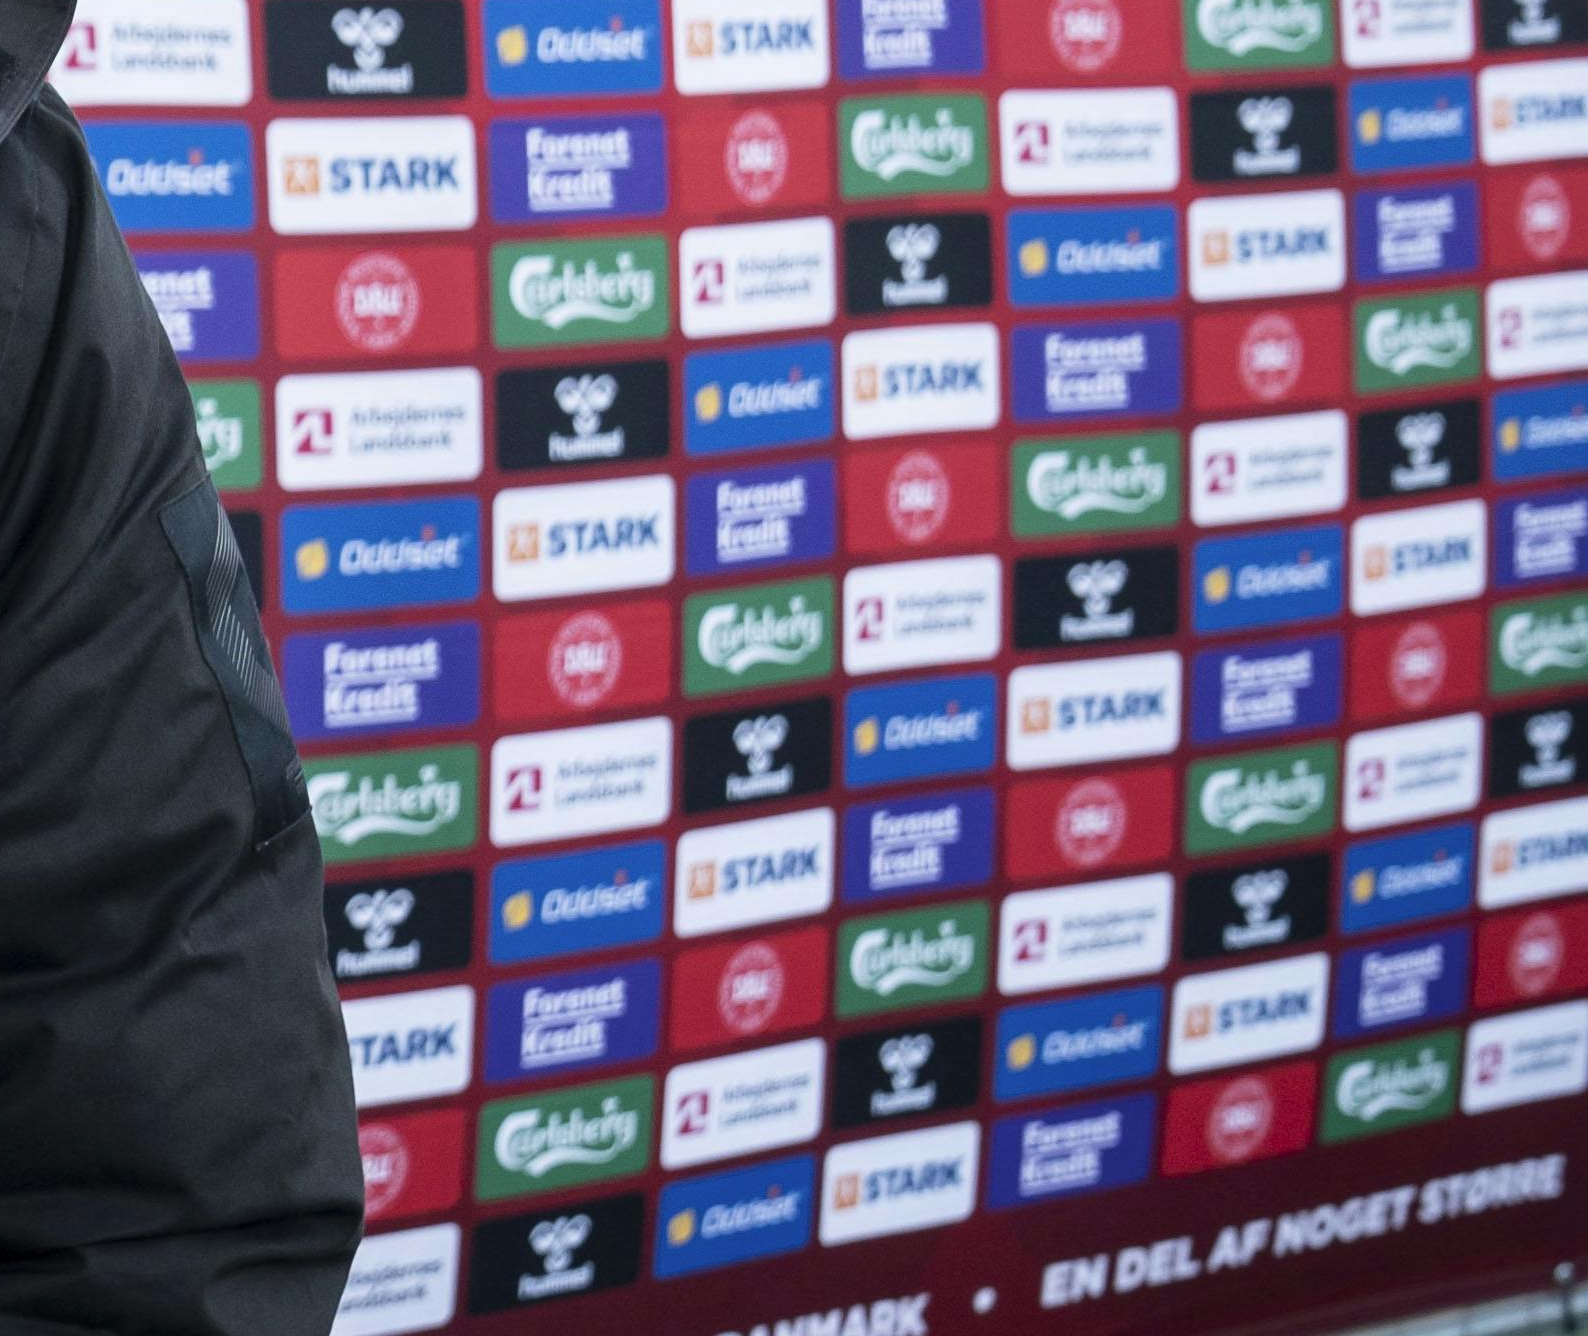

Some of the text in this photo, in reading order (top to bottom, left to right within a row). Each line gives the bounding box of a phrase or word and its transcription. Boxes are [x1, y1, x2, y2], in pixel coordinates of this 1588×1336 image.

[722, 19, 814, 53] STARK
[330, 155, 458, 191] STARK
[509, 252, 655, 329] Carlsberg
[882, 365, 985, 396] STARK
[548, 515, 659, 557] STARK
[698, 597, 822, 674] Carlsberg
[1057, 689, 1166, 725] STARK
[310, 765, 461, 845] Carlsberg
[720, 845, 818, 888] STARK
[349, 1022, 456, 1066] TARK
[495, 1096, 637, 1176] Carlsberg
[863, 1154, 960, 1201] STARK
[1042, 1254, 1109, 1309] EN
[1114, 1237, 1197, 1293] DEL
[1209, 1219, 1270, 1271] AF
[1273, 1185, 1415, 1257] NOGET
